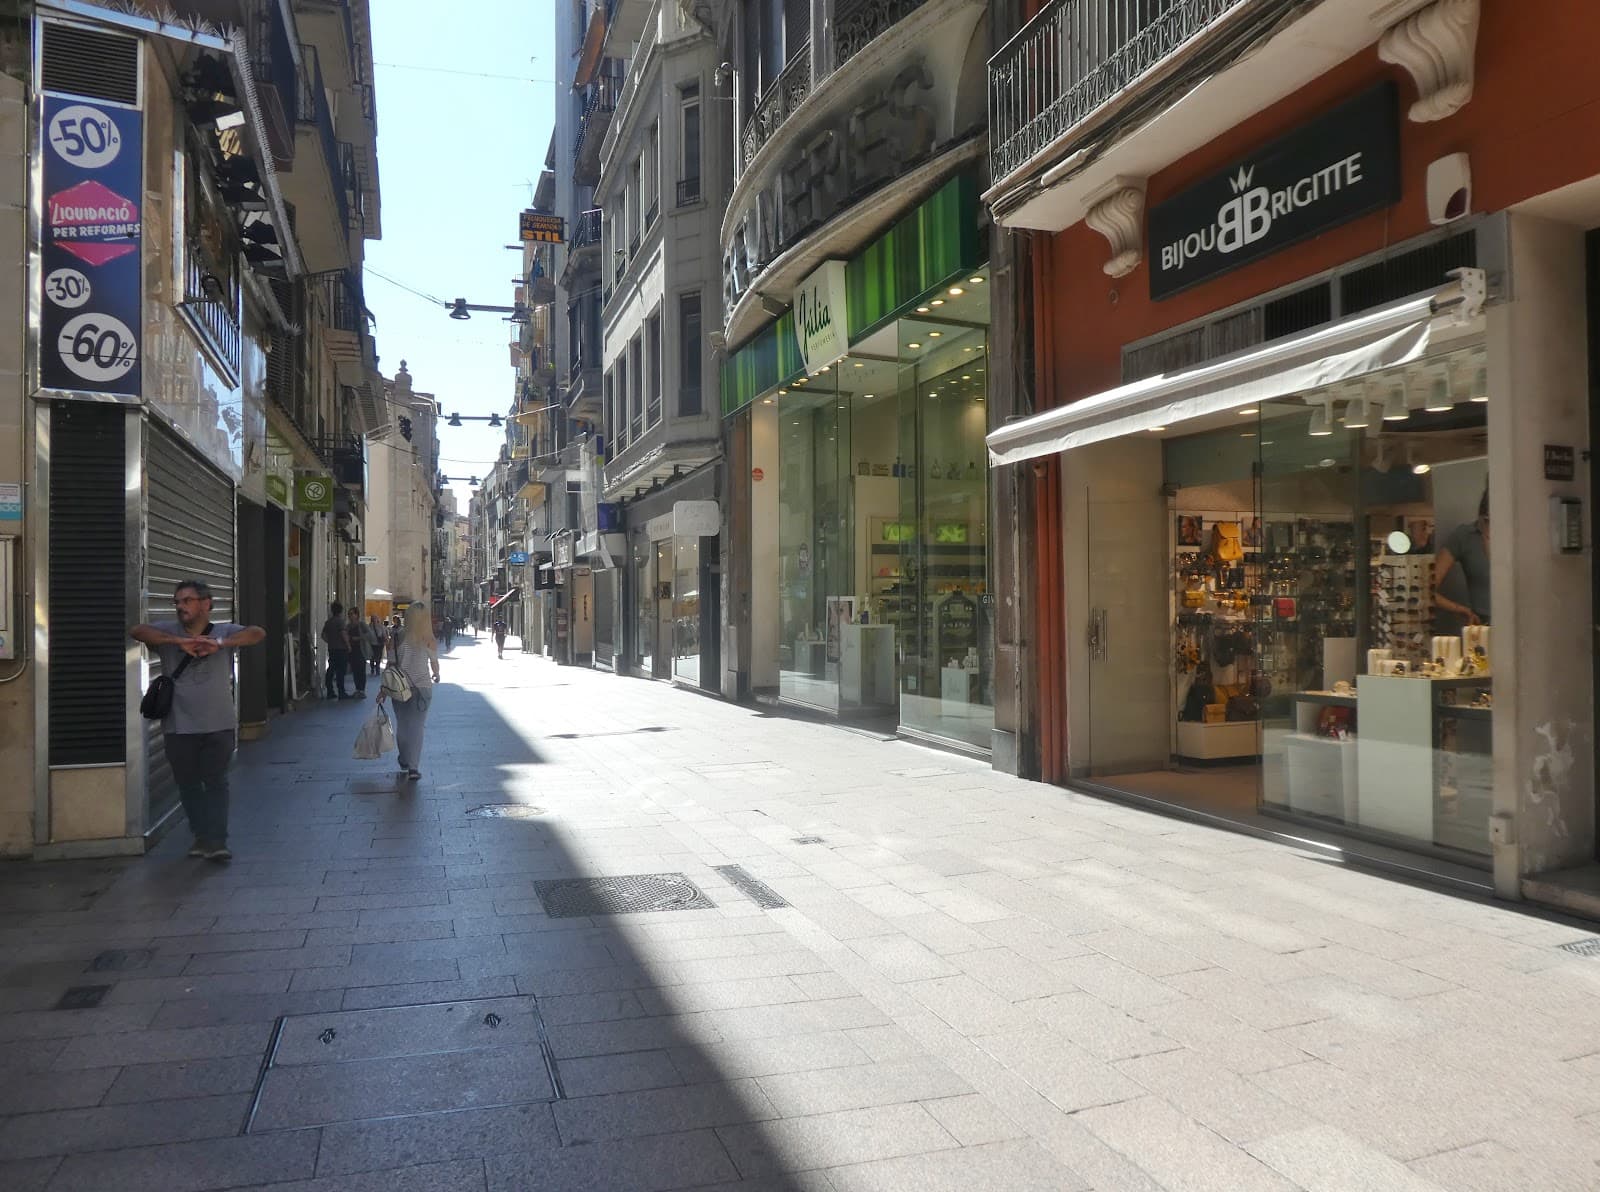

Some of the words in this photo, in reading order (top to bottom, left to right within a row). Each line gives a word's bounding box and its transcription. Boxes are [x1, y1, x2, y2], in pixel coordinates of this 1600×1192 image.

[53, 116, 118, 157] -50%
[52, 202, 129, 224] LIQUIDACIÓ
[53, 226, 77, 238] PER
[79, 223, 141, 237] REFORMES
[522, 229, 563, 243] STIL
[1161, 223, 1215, 271] BIJOU
[48, 275, 89, 300] -30%
[62, 323, 135, 370] -60%
